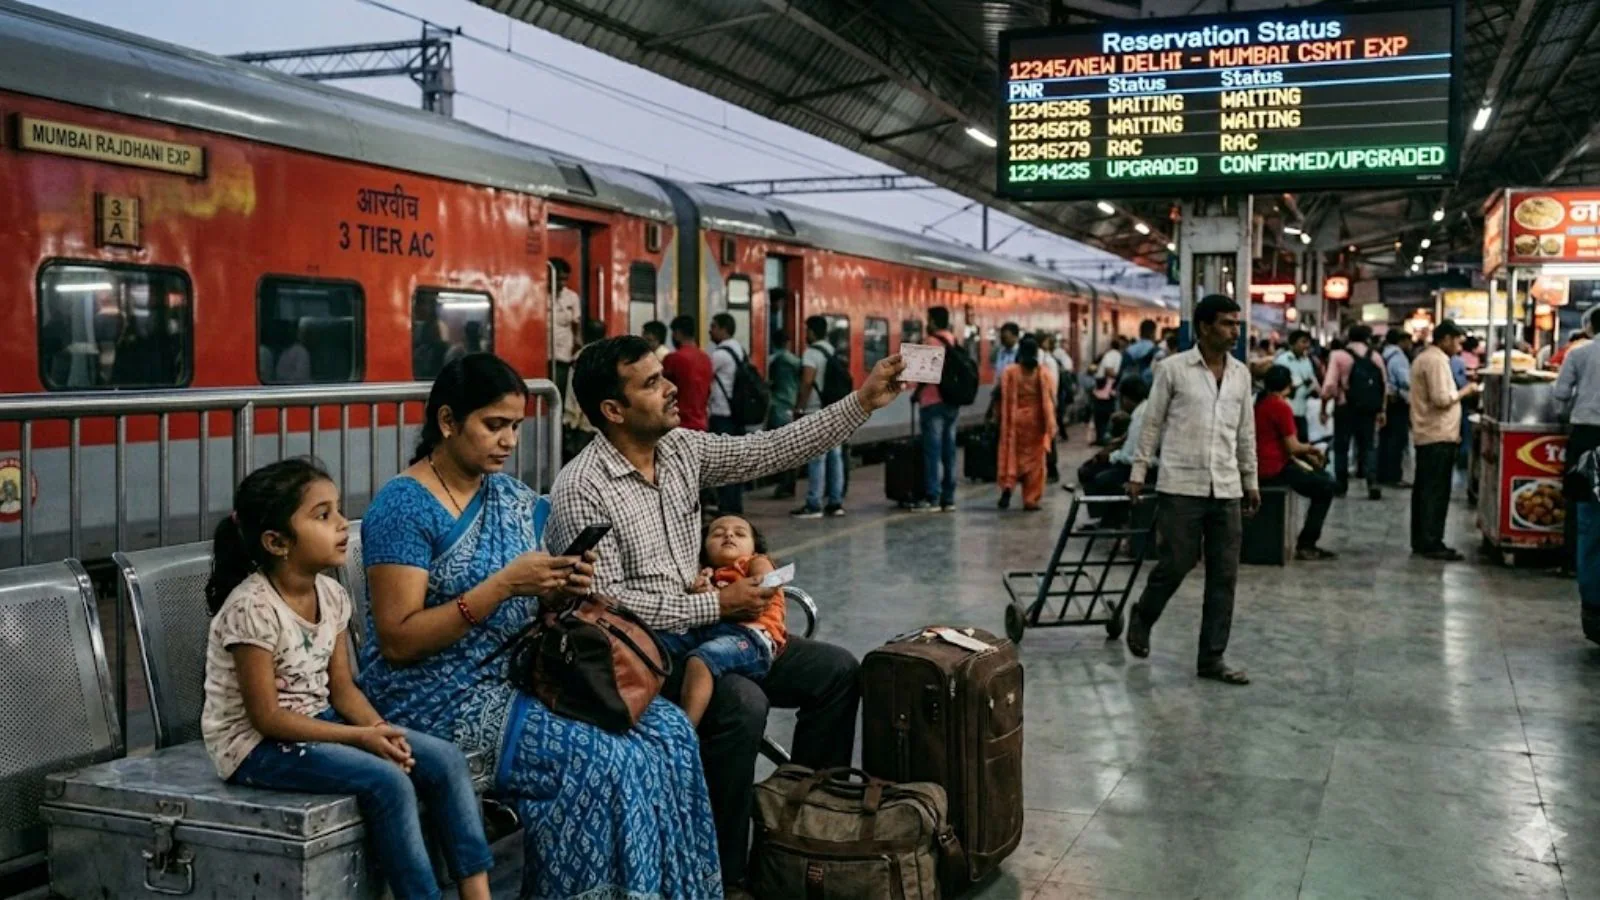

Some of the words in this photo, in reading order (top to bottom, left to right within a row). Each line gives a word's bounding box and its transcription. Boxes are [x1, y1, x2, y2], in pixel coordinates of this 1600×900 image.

[1102, 25, 1250, 54] Reservation
[1257, 20, 1341, 43] Status
[1009, 55, 1116, 80] 12345/NEW
[1123, 51, 1183, 74] DELHI
[1208, 45, 1290, 68] MUMBAI
[1298, 40, 1356, 62] CSMT
[1364, 36, 1408, 58] EXP
[1009, 82, 1045, 99] PNR
[1107, 76, 1167, 93] Status
[1220, 69, 1284, 87] Status
[1009, 99, 1092, 120] 12345296
[1107, 94, 1184, 115] WAITING
[1220, 87, 1302, 109] WAITING
[1009, 120, 1092, 141] 12345678
[1107, 115, 1184, 136] WAITING
[1220, 109, 1302, 130] WAITING
[32, 123, 92, 150] MUMBAI
[95, 134, 164, 162] RAJDHANI
[167, 147, 191, 166] EXP
[1009, 140, 1092, 161] 12345279
[1107, 138, 1144, 157] RAC
[1220, 133, 1258, 152] RAC
[1009, 161, 1091, 182] 12344235
[1107, 156, 1199, 178] UPGRADED
[1219, 146, 1445, 174] CONFIRMED/UPGRADED
[111, 199, 122, 217] 3
[1568, 199, 1600, 223] न
[109, 222, 124, 240] A
[339, 221, 350, 250] 3
[357, 223, 404, 256] TIER
[408, 231, 435, 259] AC
